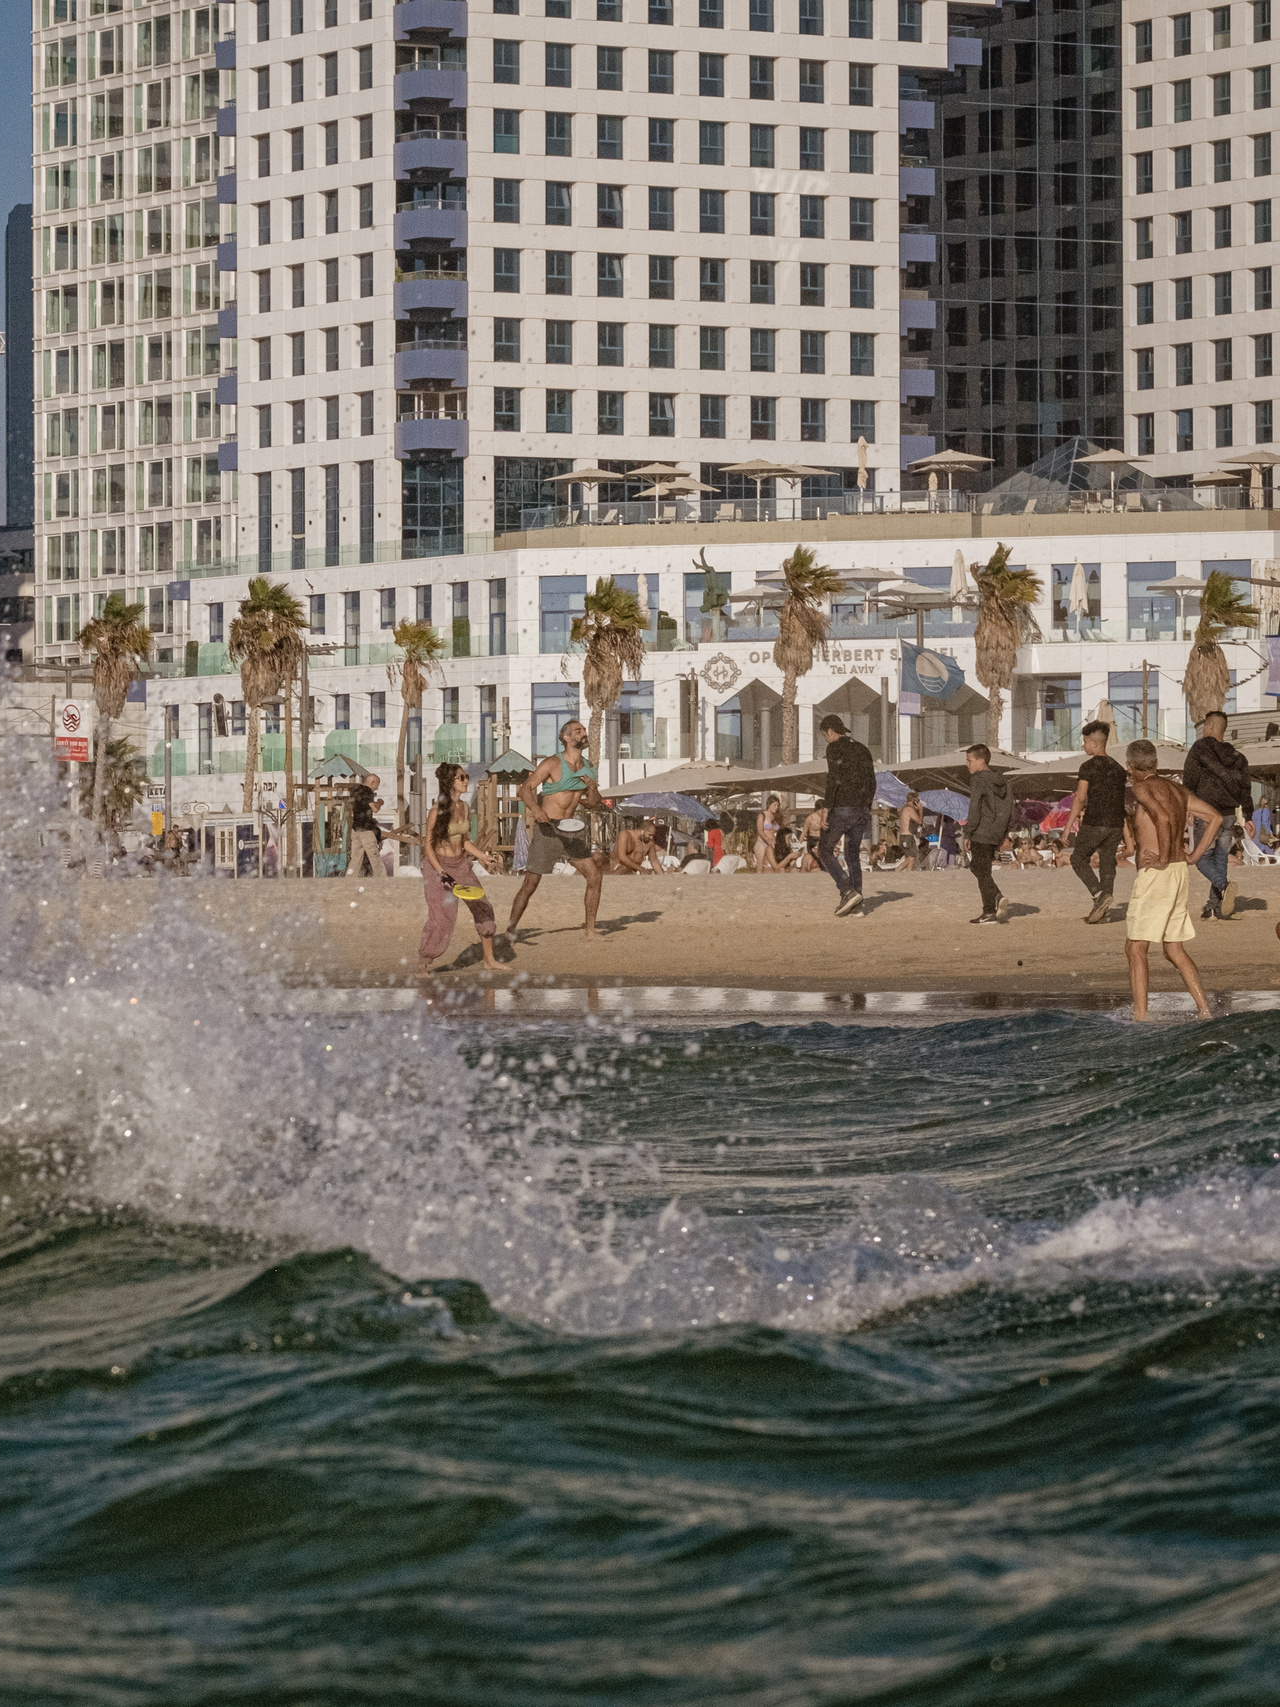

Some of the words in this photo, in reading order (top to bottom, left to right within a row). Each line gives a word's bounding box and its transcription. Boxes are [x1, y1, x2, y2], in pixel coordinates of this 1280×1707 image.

[813, 648, 885, 662] HERBERT
[830, 664, 847, 674] Tel
[850, 663, 875, 674] Aviv
